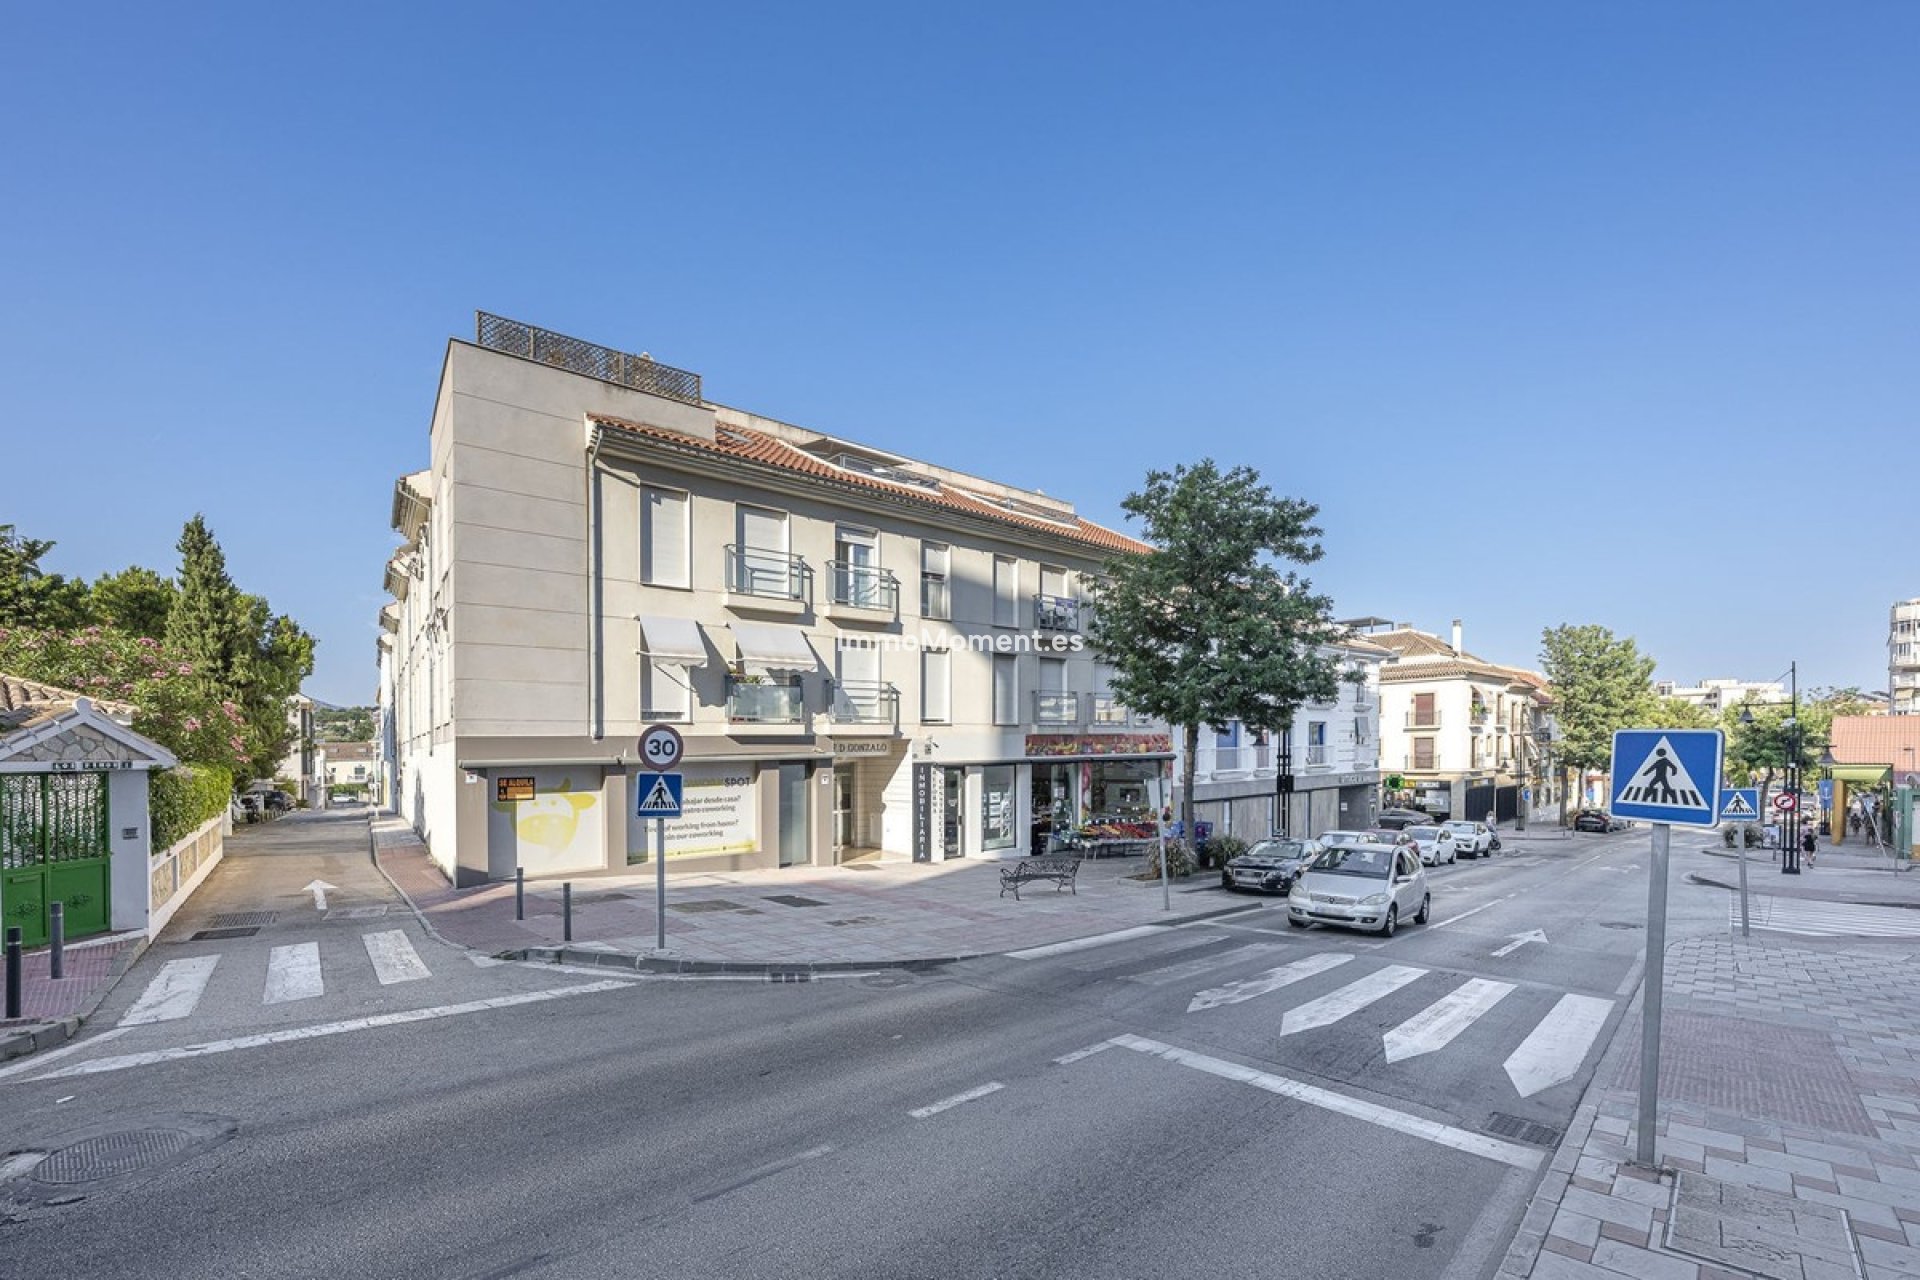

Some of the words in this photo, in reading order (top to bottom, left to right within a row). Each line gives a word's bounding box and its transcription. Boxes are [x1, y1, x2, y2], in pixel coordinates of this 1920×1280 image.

[648, 739, 675, 756] 30
[848, 743, 887, 752] GONZALO
[918, 766, 926, 859] INMOBILIARIA
